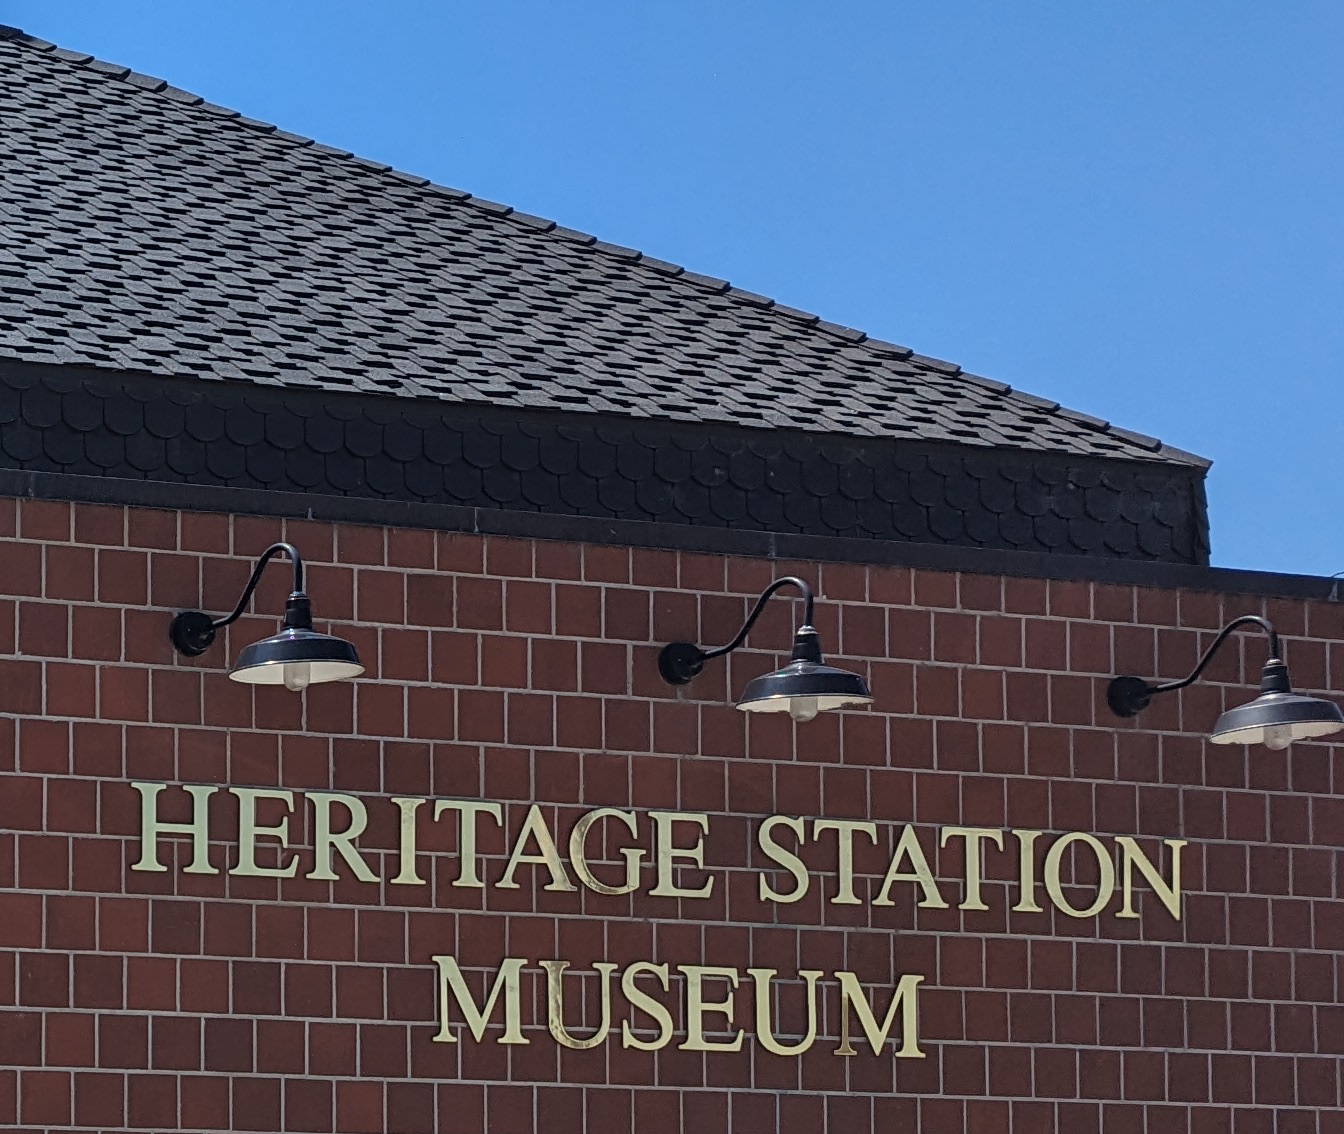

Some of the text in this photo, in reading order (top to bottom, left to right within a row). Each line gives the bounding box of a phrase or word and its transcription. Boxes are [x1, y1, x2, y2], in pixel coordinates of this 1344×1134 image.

[130, 780, 1188, 921] HERITAGE STATION
[432, 954, 927, 1060] MUSEUM
